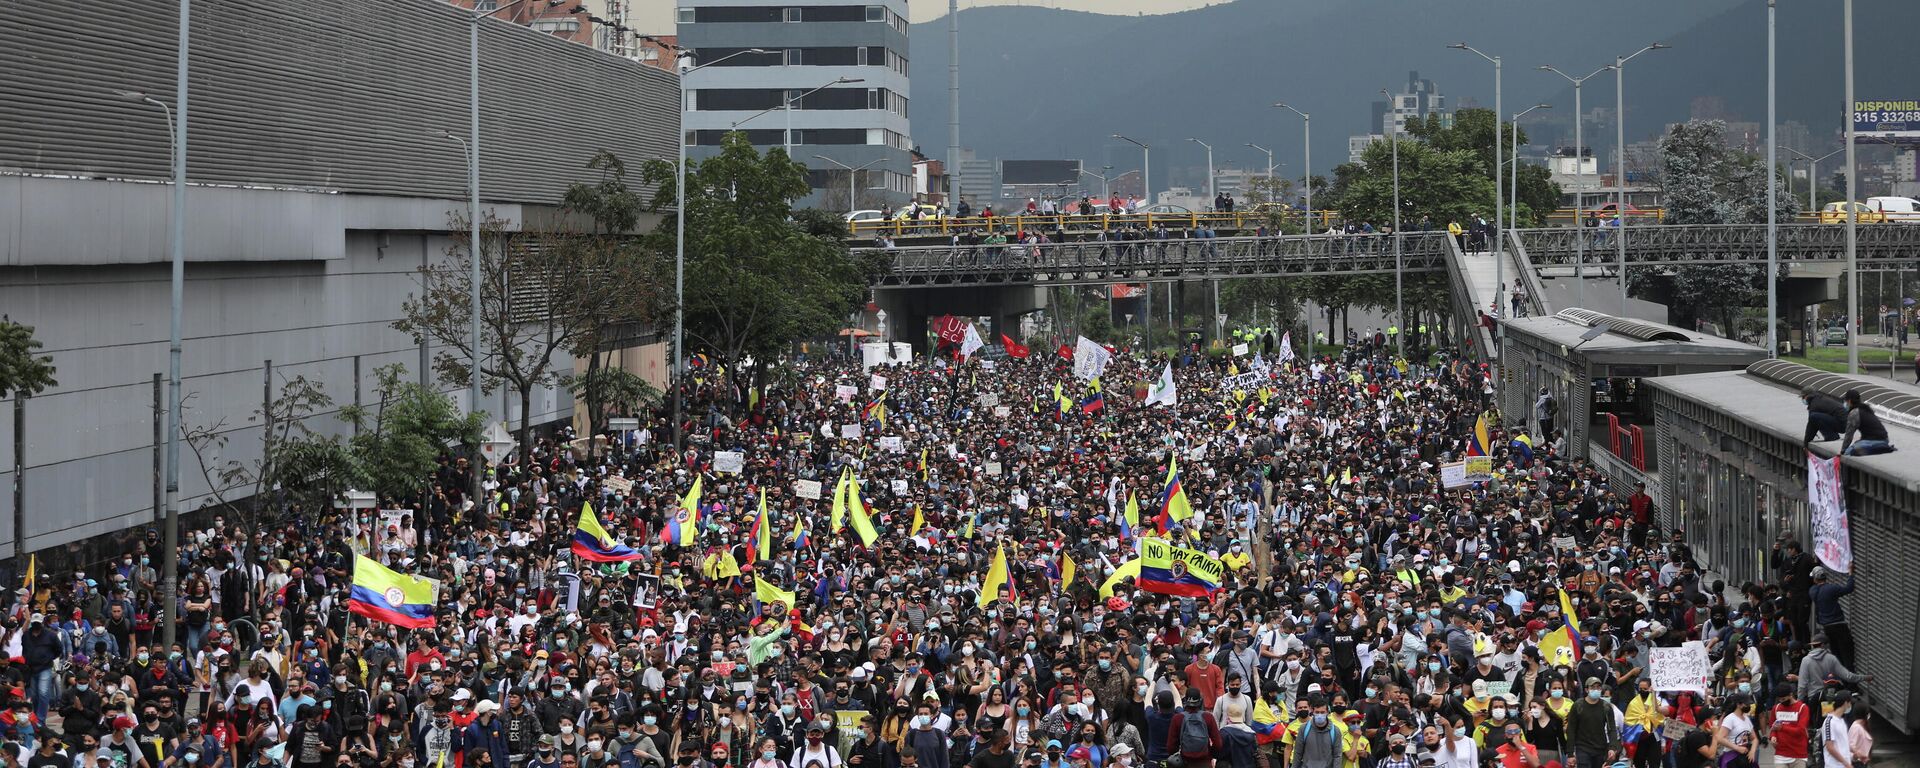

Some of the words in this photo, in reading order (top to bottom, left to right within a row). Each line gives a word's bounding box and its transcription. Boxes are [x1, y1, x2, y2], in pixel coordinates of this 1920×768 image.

[1854, 112, 1878, 122] 315
[1881, 111, 1920, 122] 33268
[1148, 544, 1163, 559] NO
[1169, 546, 1190, 560] HAY
[1504, 660, 1517, 668] NIKE
